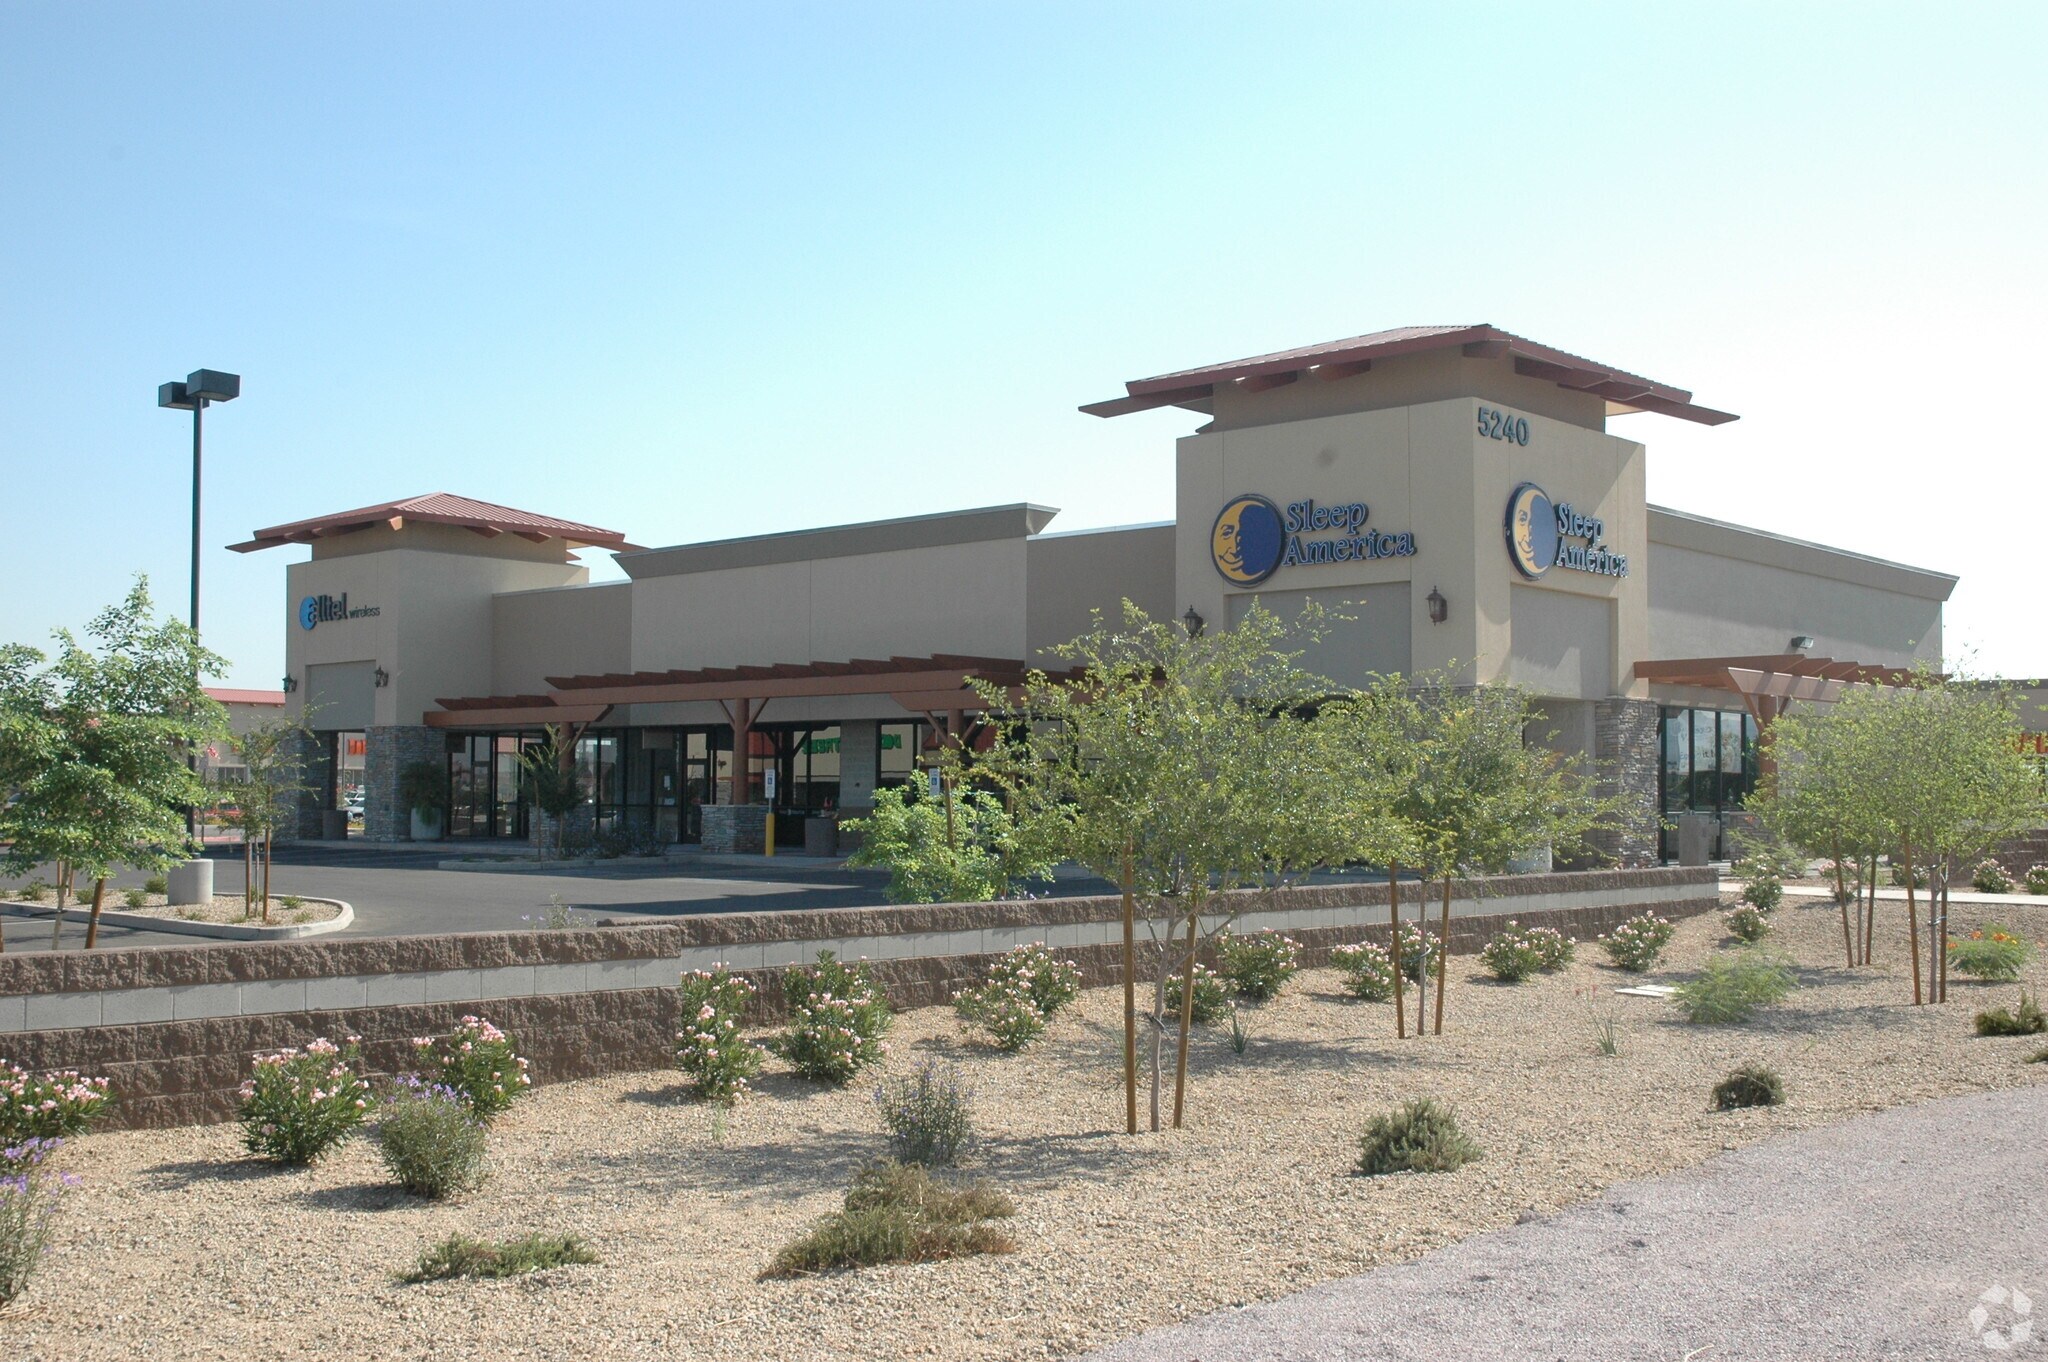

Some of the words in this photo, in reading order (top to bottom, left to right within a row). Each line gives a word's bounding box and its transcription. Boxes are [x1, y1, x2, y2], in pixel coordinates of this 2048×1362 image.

[1477, 406, 1530, 447] 5240
[1284, 498, 1370, 535] Sleep
[1556, 502, 1604, 548] Sleep
[1282, 527, 1418, 567] America
[1556, 536, 1630, 579] America
[304, 592, 348, 625] alltel
[348, 605, 381, 619] wireless
